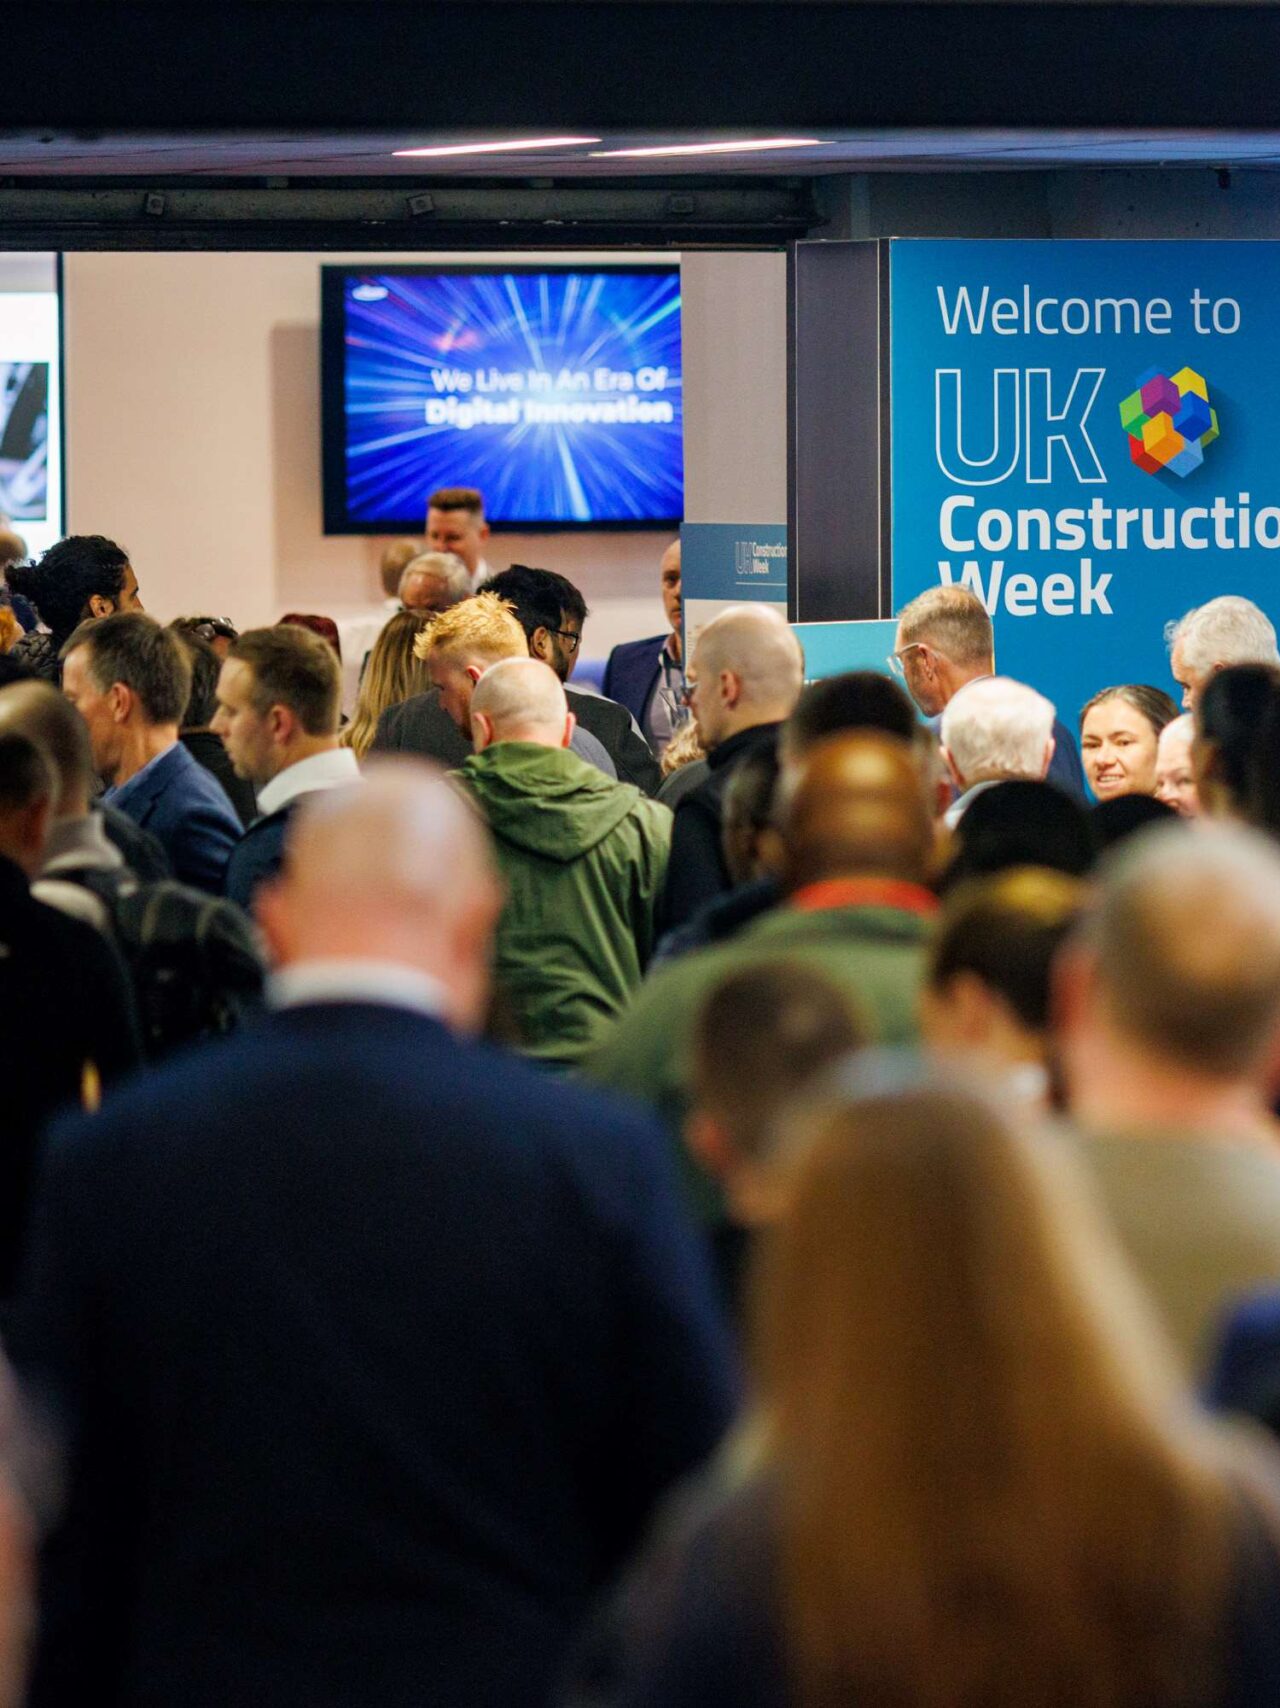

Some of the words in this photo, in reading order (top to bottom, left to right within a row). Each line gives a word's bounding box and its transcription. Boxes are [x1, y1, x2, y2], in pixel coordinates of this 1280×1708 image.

[936, 284, 1172, 335] Welcome
[1190, 288, 1241, 335] to
[431, 367, 472, 392] We
[475, 367, 524, 392] Live
[555, 367, 590, 391] An
[594, 367, 634, 391] Era
[636, 365, 669, 391] Of
[425, 395, 520, 430] Digital
[525, 394, 674, 424] Innovation
[935, 368, 1107, 487] UK
[938, 558, 1114, 616] Week
